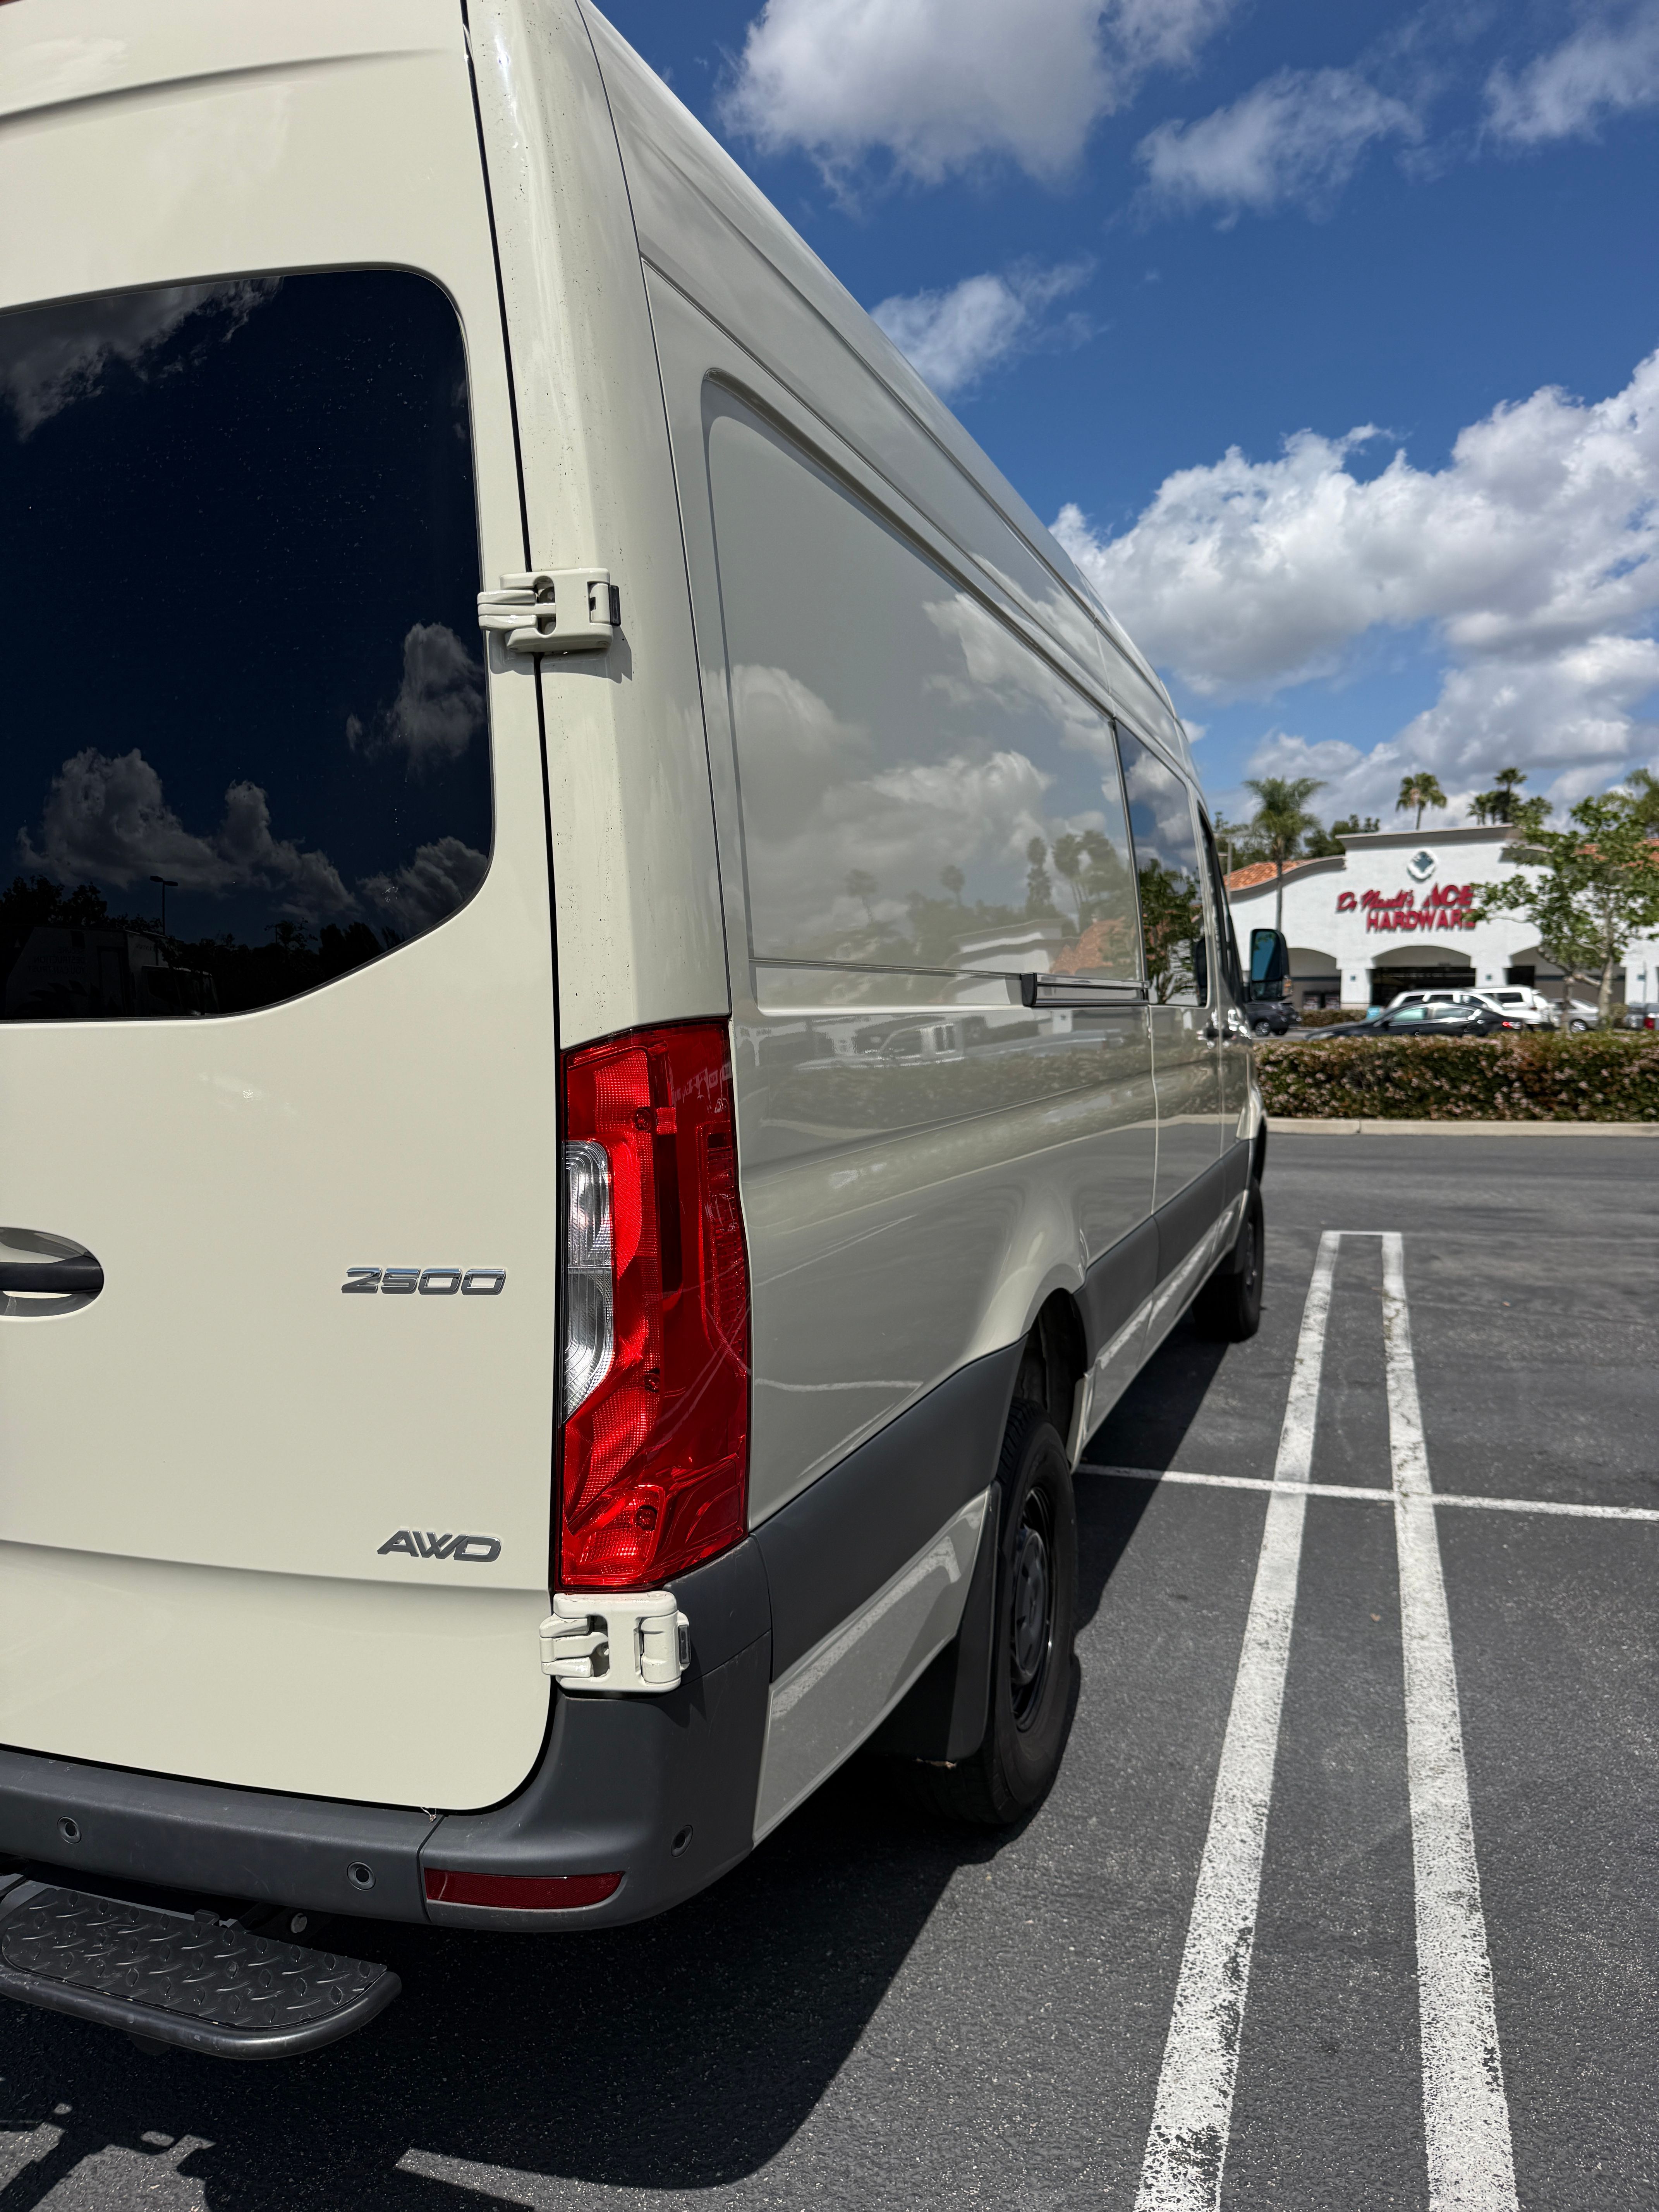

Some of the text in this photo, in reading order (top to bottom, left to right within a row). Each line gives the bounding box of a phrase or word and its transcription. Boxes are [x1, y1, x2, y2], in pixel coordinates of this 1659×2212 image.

[1423, 883, 1474, 907] ACE
[1367, 908, 1476, 930] HARDWARE
[341, 1267, 507, 1295] 2500
[377, 1530, 502, 1562] AWD
